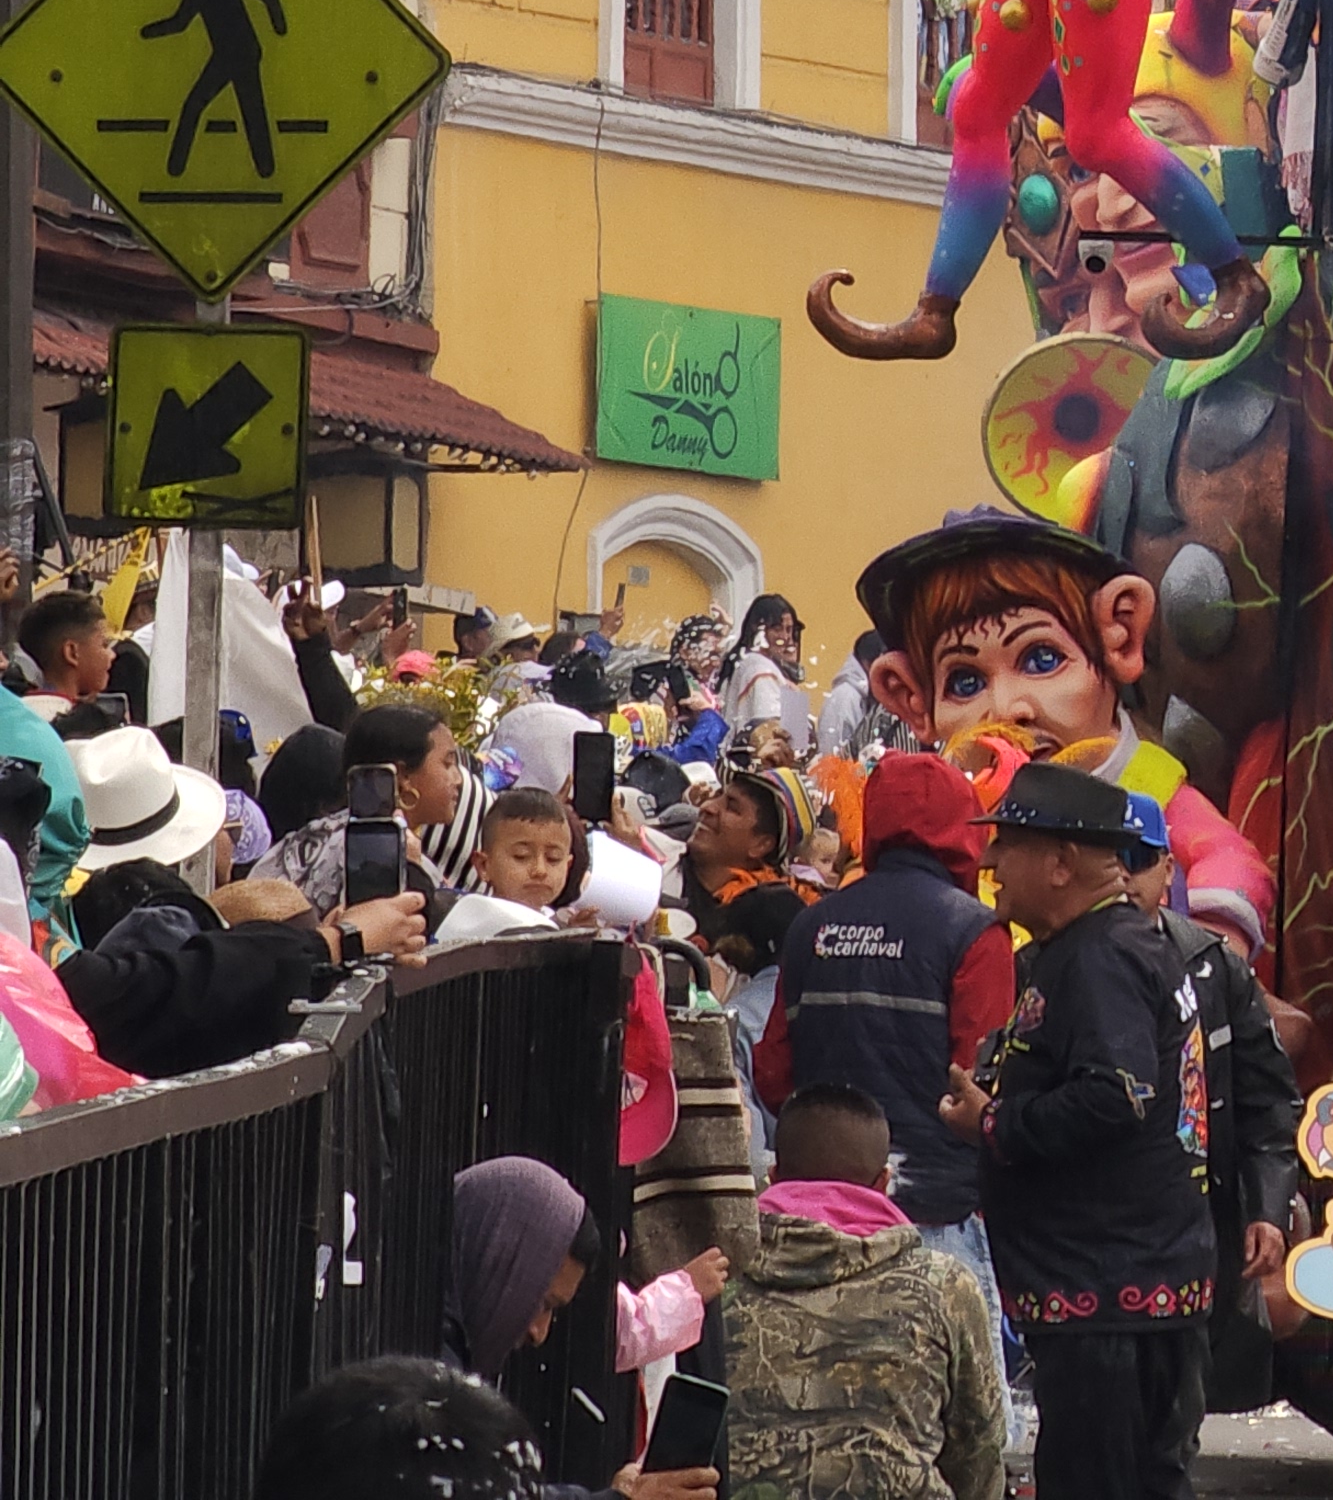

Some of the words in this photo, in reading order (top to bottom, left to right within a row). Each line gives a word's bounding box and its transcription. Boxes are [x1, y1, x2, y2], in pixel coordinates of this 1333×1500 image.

[650, 414, 711, 465] Danny
[838, 925, 885, 943] corpo
[833, 938, 905, 959] carnaval
